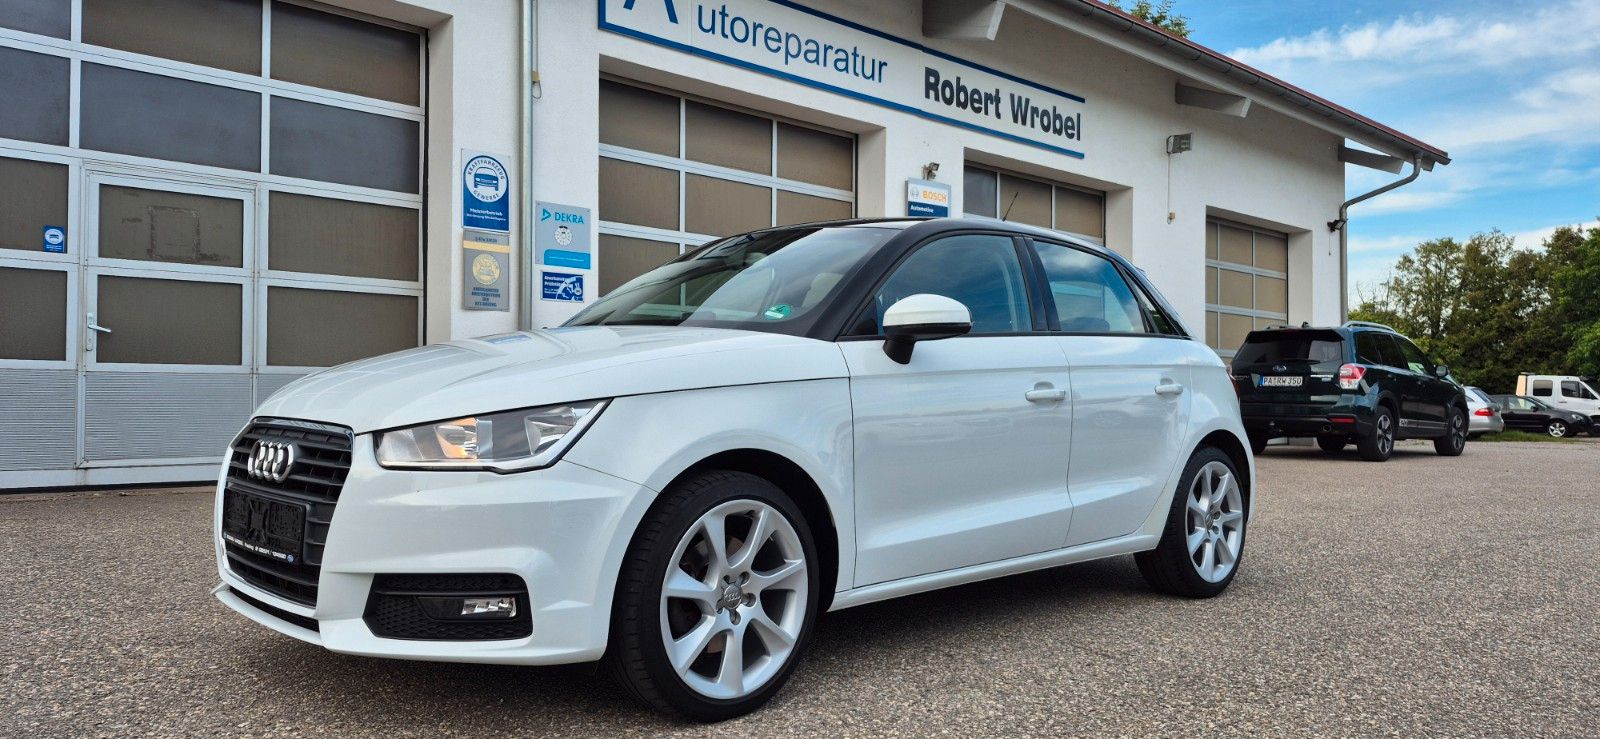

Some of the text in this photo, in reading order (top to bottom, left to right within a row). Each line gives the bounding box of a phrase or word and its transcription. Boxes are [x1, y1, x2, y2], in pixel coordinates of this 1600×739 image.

[924, 66, 1081, 142] Robert Wrobel
[923, 191, 947, 202] BOSCH
[554, 212, 584, 224] DEKRA
